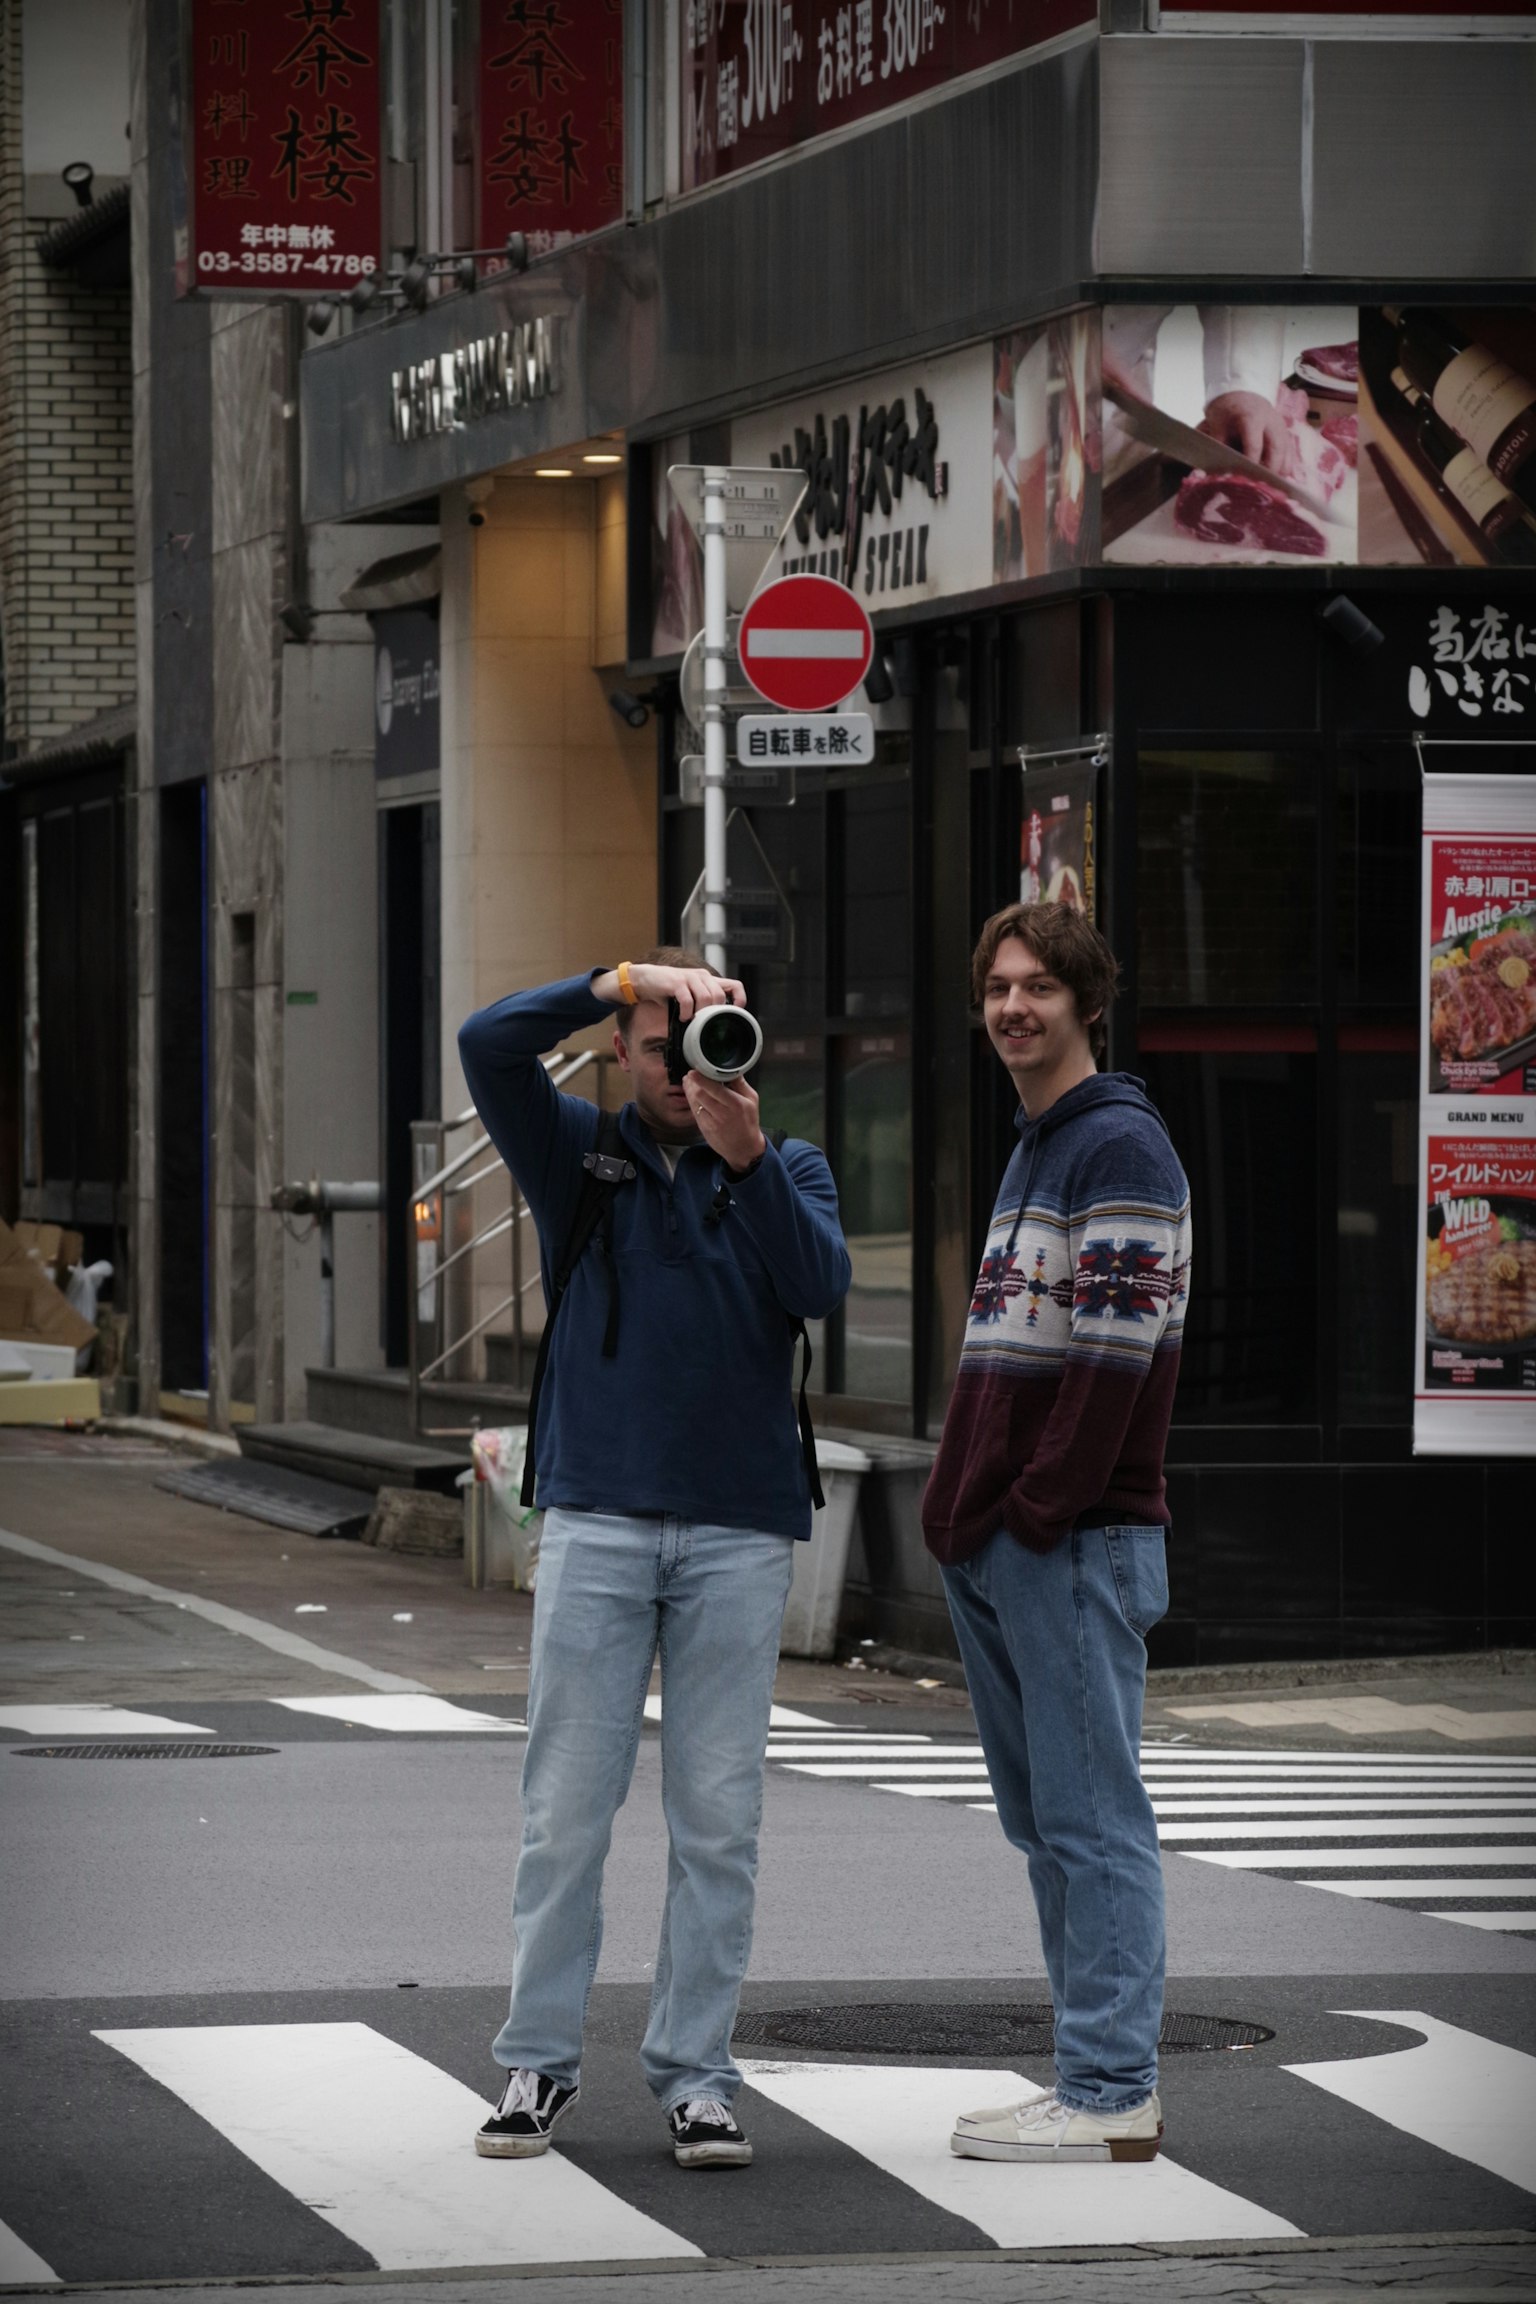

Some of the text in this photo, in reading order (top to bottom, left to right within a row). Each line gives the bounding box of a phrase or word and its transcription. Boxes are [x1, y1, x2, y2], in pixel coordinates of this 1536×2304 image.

[203, 0, 260, 200] 川料理
[240, 222, 336, 249] 年中無休
[198, 250, 377, 275] 03-3587-4786
[865, 523, 930, 596] STEAK
[748, 727, 863, 757] 自転車を除く
[1441, 901, 1502, 939] Aussie
[1448, 1112, 1524, 1124] GRAND MENU
[1433, 1189, 1451, 1205] THE
[1442, 1199, 1491, 1231] WILD
